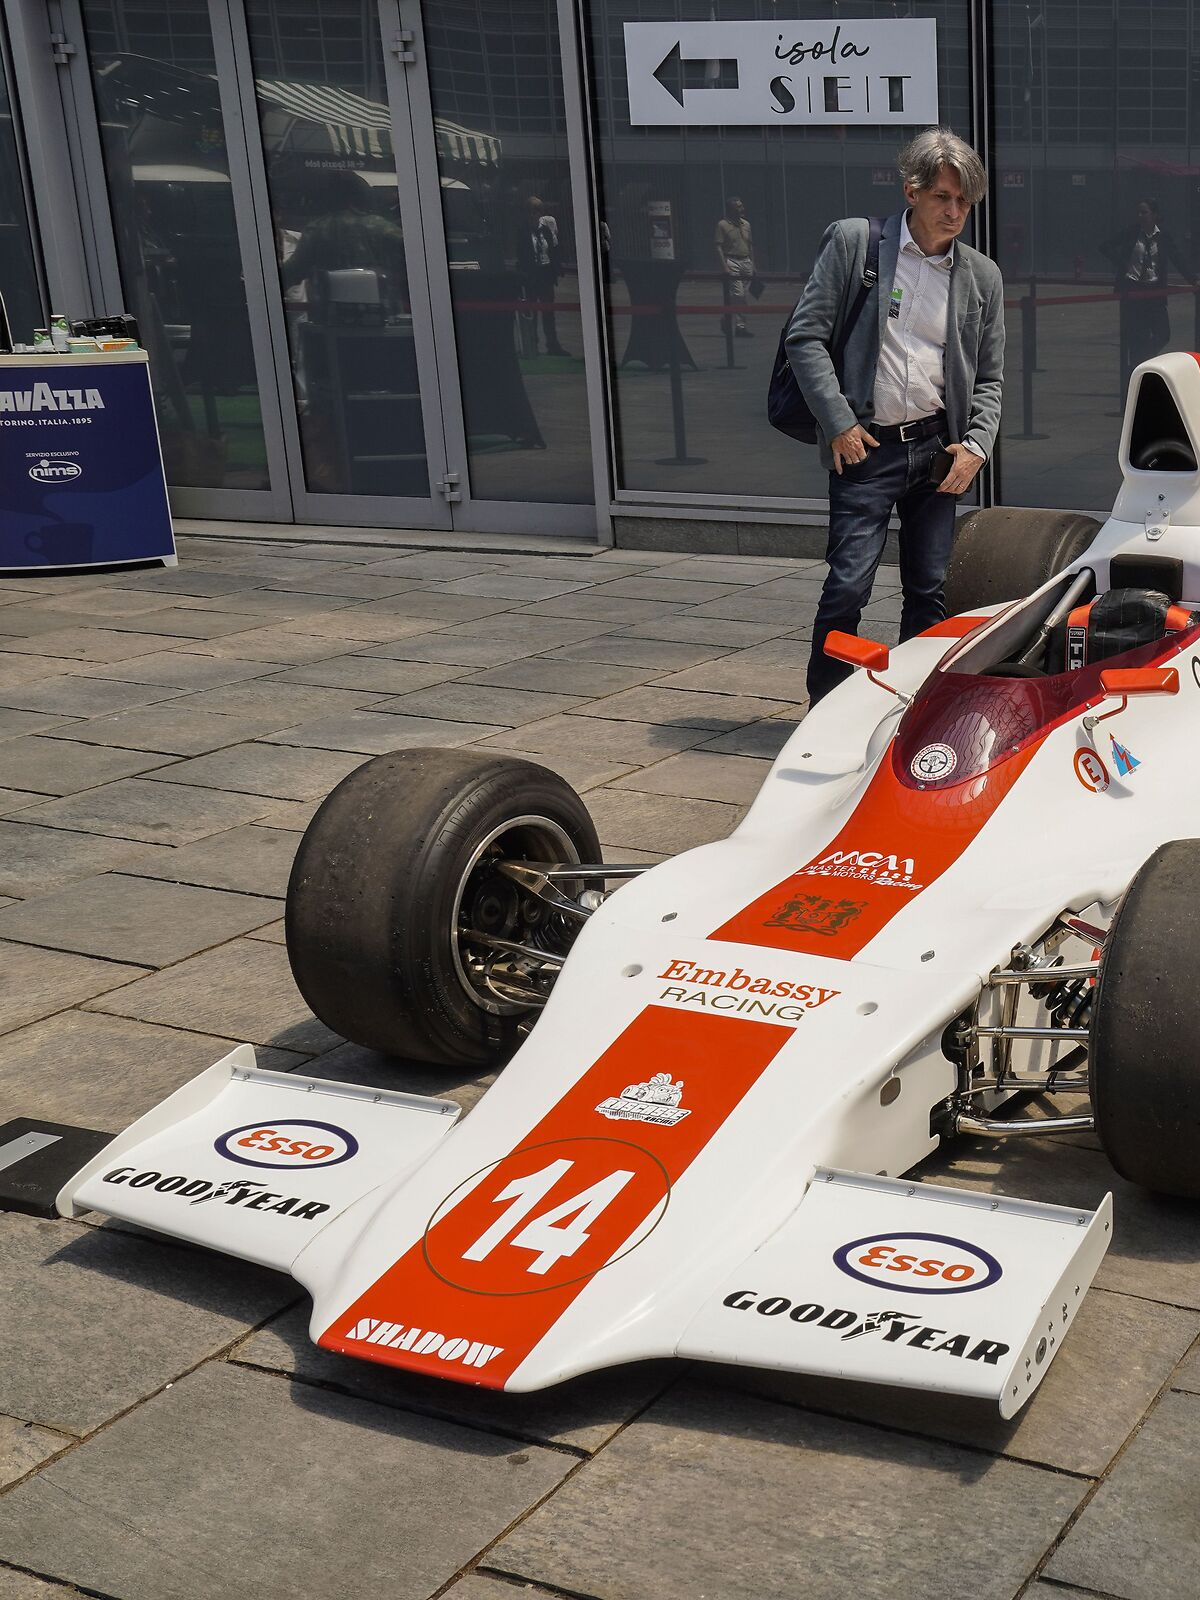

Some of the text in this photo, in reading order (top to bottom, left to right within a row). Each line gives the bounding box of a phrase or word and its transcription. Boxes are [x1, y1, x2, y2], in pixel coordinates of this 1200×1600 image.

[774, 25, 870, 65] isola
[0, 382, 106, 412] AVAZZA
[33, 459, 78, 477] nims
[831, 870, 876, 881] MOTORS
[859, 867, 913, 882] CLASS
[656, 959, 842, 1009] Embassy
[659, 986, 805, 1021] RACING
[460, 1158, 636, 1276] 14
[345, 1317, 506, 1369] SHADOW
